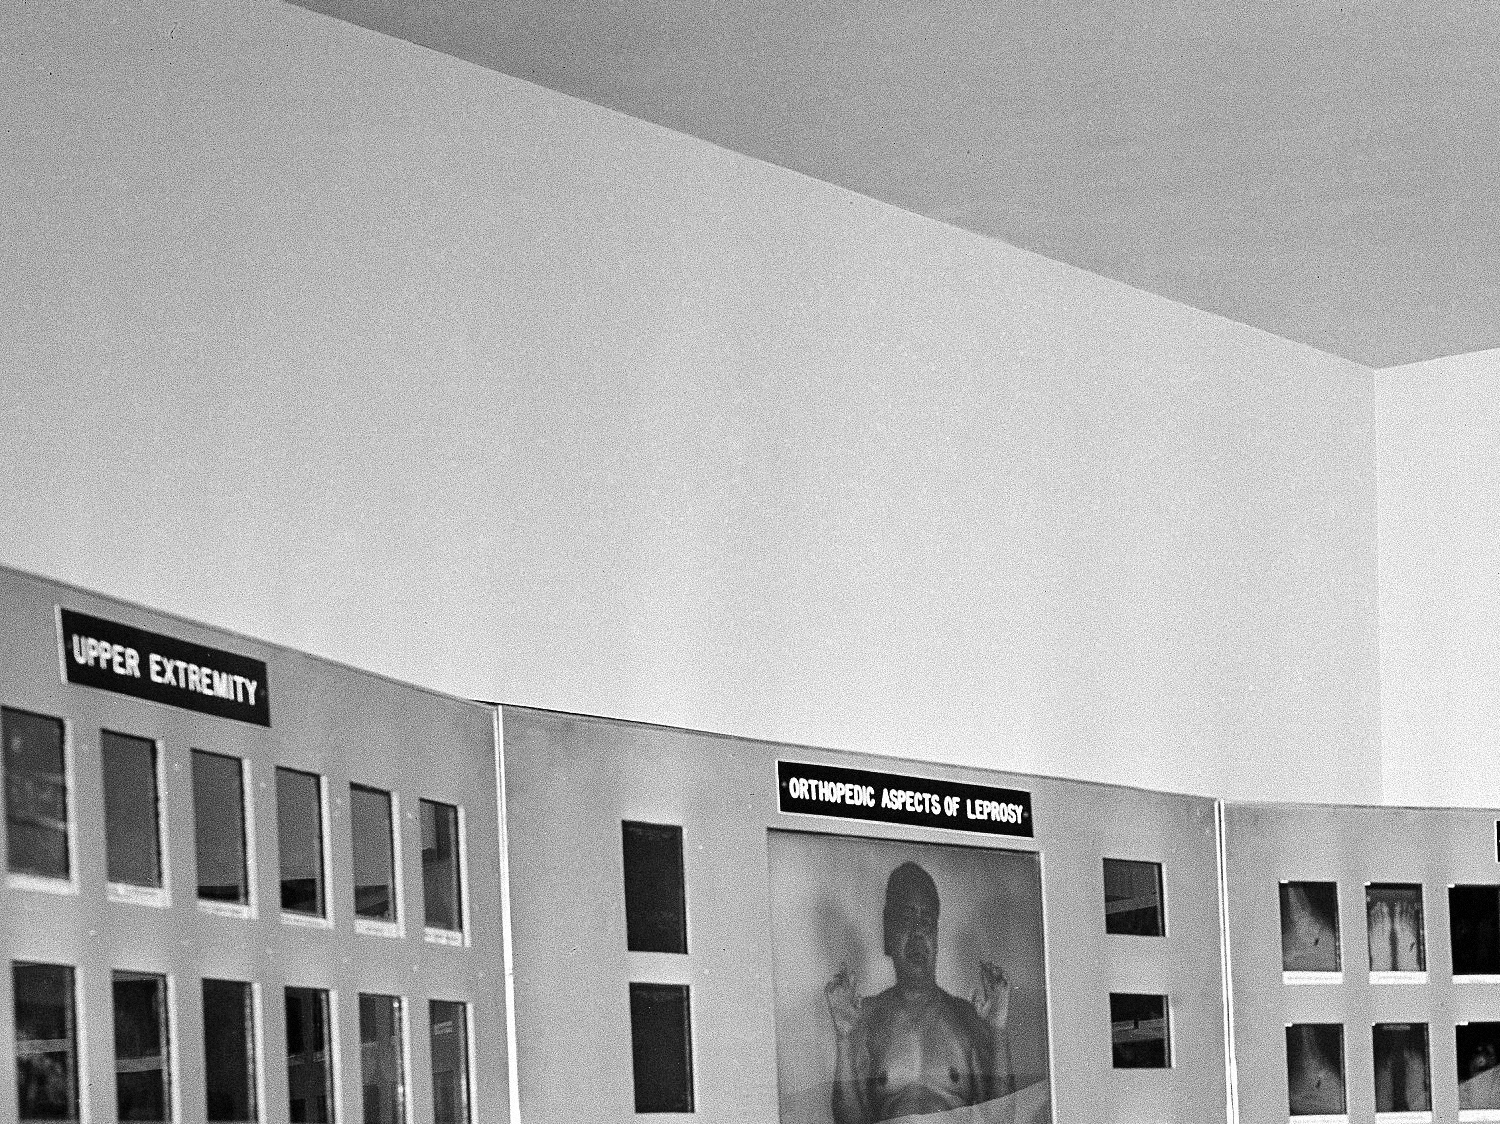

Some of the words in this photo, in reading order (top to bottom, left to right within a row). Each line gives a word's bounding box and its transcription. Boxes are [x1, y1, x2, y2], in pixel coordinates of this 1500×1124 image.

[71, 633, 141, 678] UPPER
[149, 652, 257, 705] EXTREMITY
[789, 777, 875, 807] ORTHOPEDIC
[881, 788, 941, 815] ASPECTS
[943, 796, 961, 817] OF
[966, 799, 1023, 824] LEPROSY
